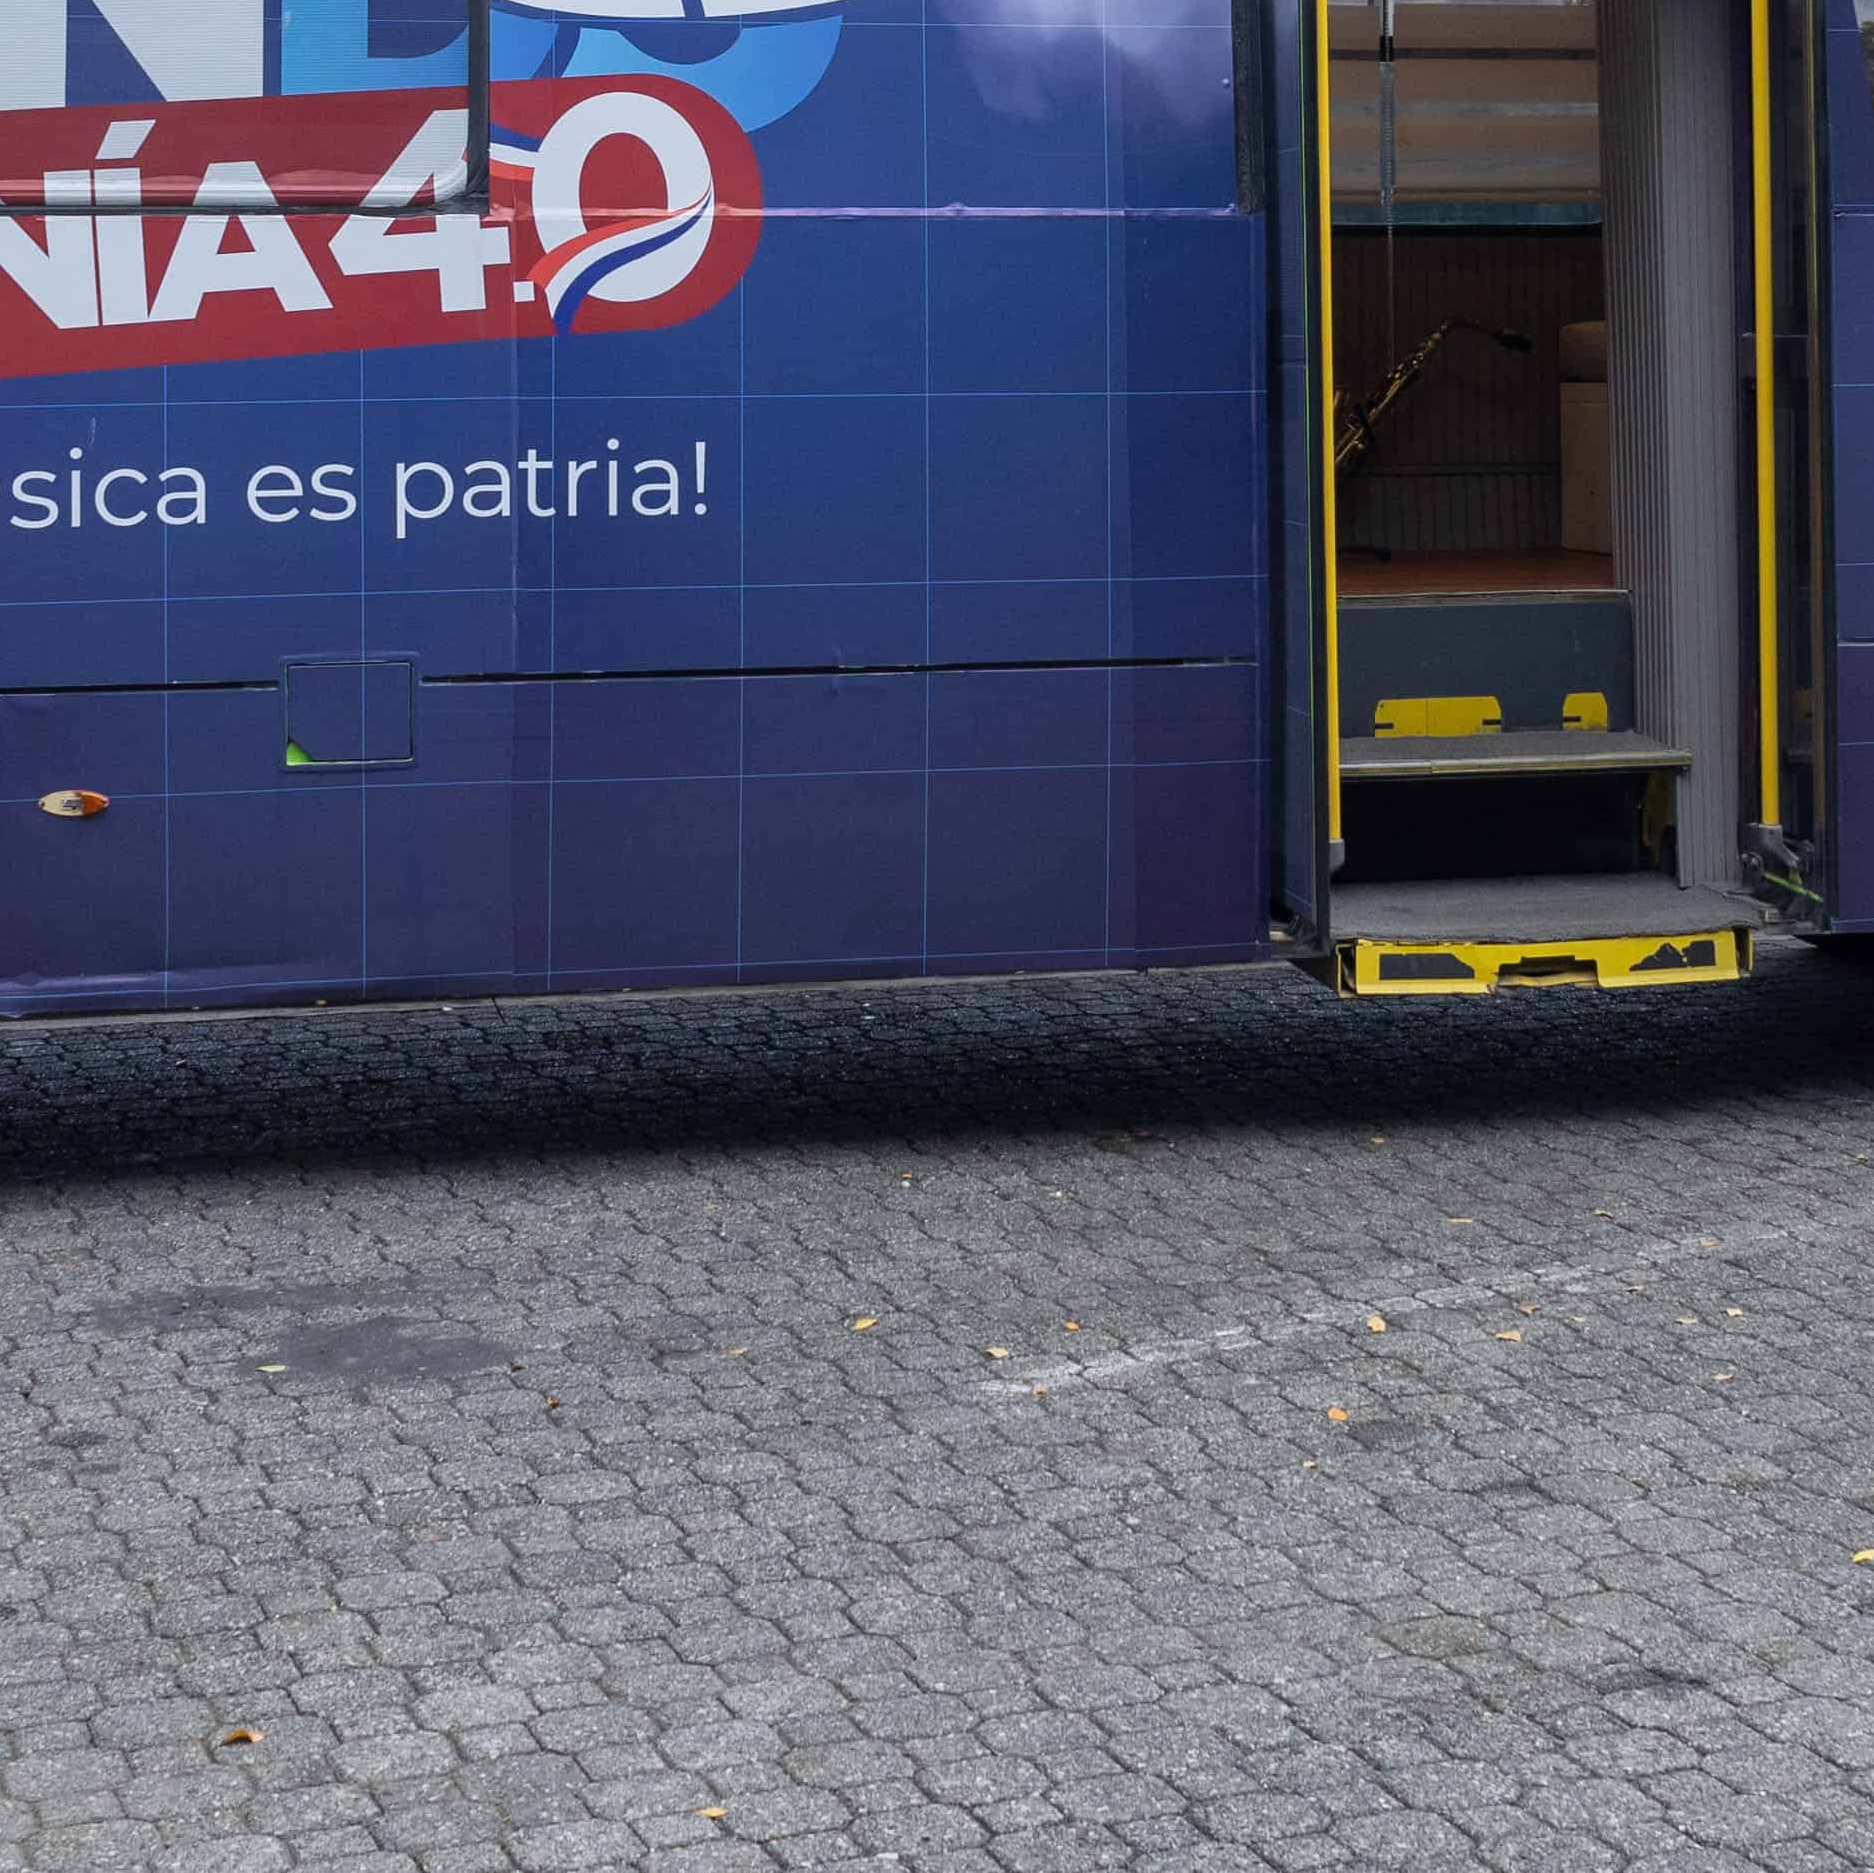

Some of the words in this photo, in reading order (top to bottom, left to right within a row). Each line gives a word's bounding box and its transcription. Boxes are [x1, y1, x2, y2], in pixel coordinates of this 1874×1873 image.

[329, 92, 714, 314] 4.0
[246, 462, 358, 524] es
[395, 437, 709, 539] patria!
